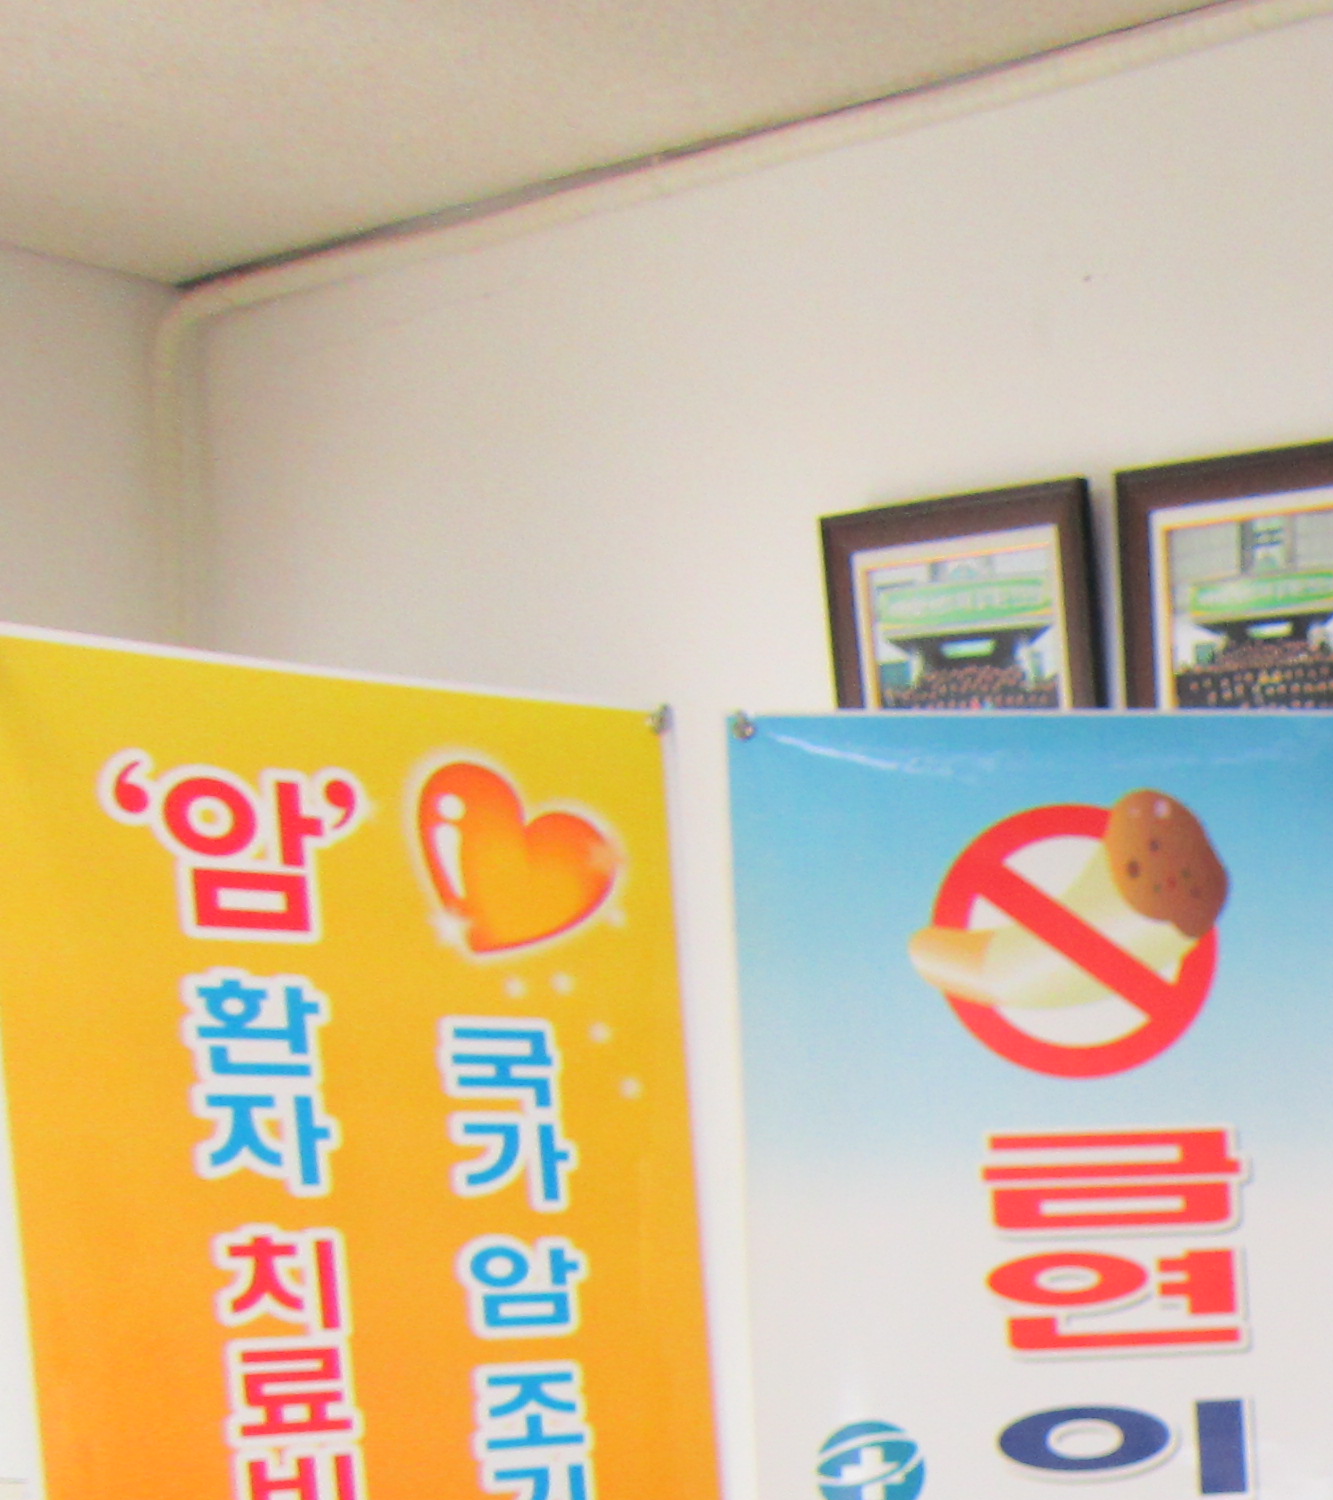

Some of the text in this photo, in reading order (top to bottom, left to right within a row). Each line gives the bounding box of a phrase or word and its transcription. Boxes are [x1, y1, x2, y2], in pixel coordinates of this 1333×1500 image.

[194, 979, 331, 1187] 환자
[450, 1026, 570, 1201] 국가
[469, 1246, 580, 1328] 암
[982, 1129, 1241, 1351] 금연
